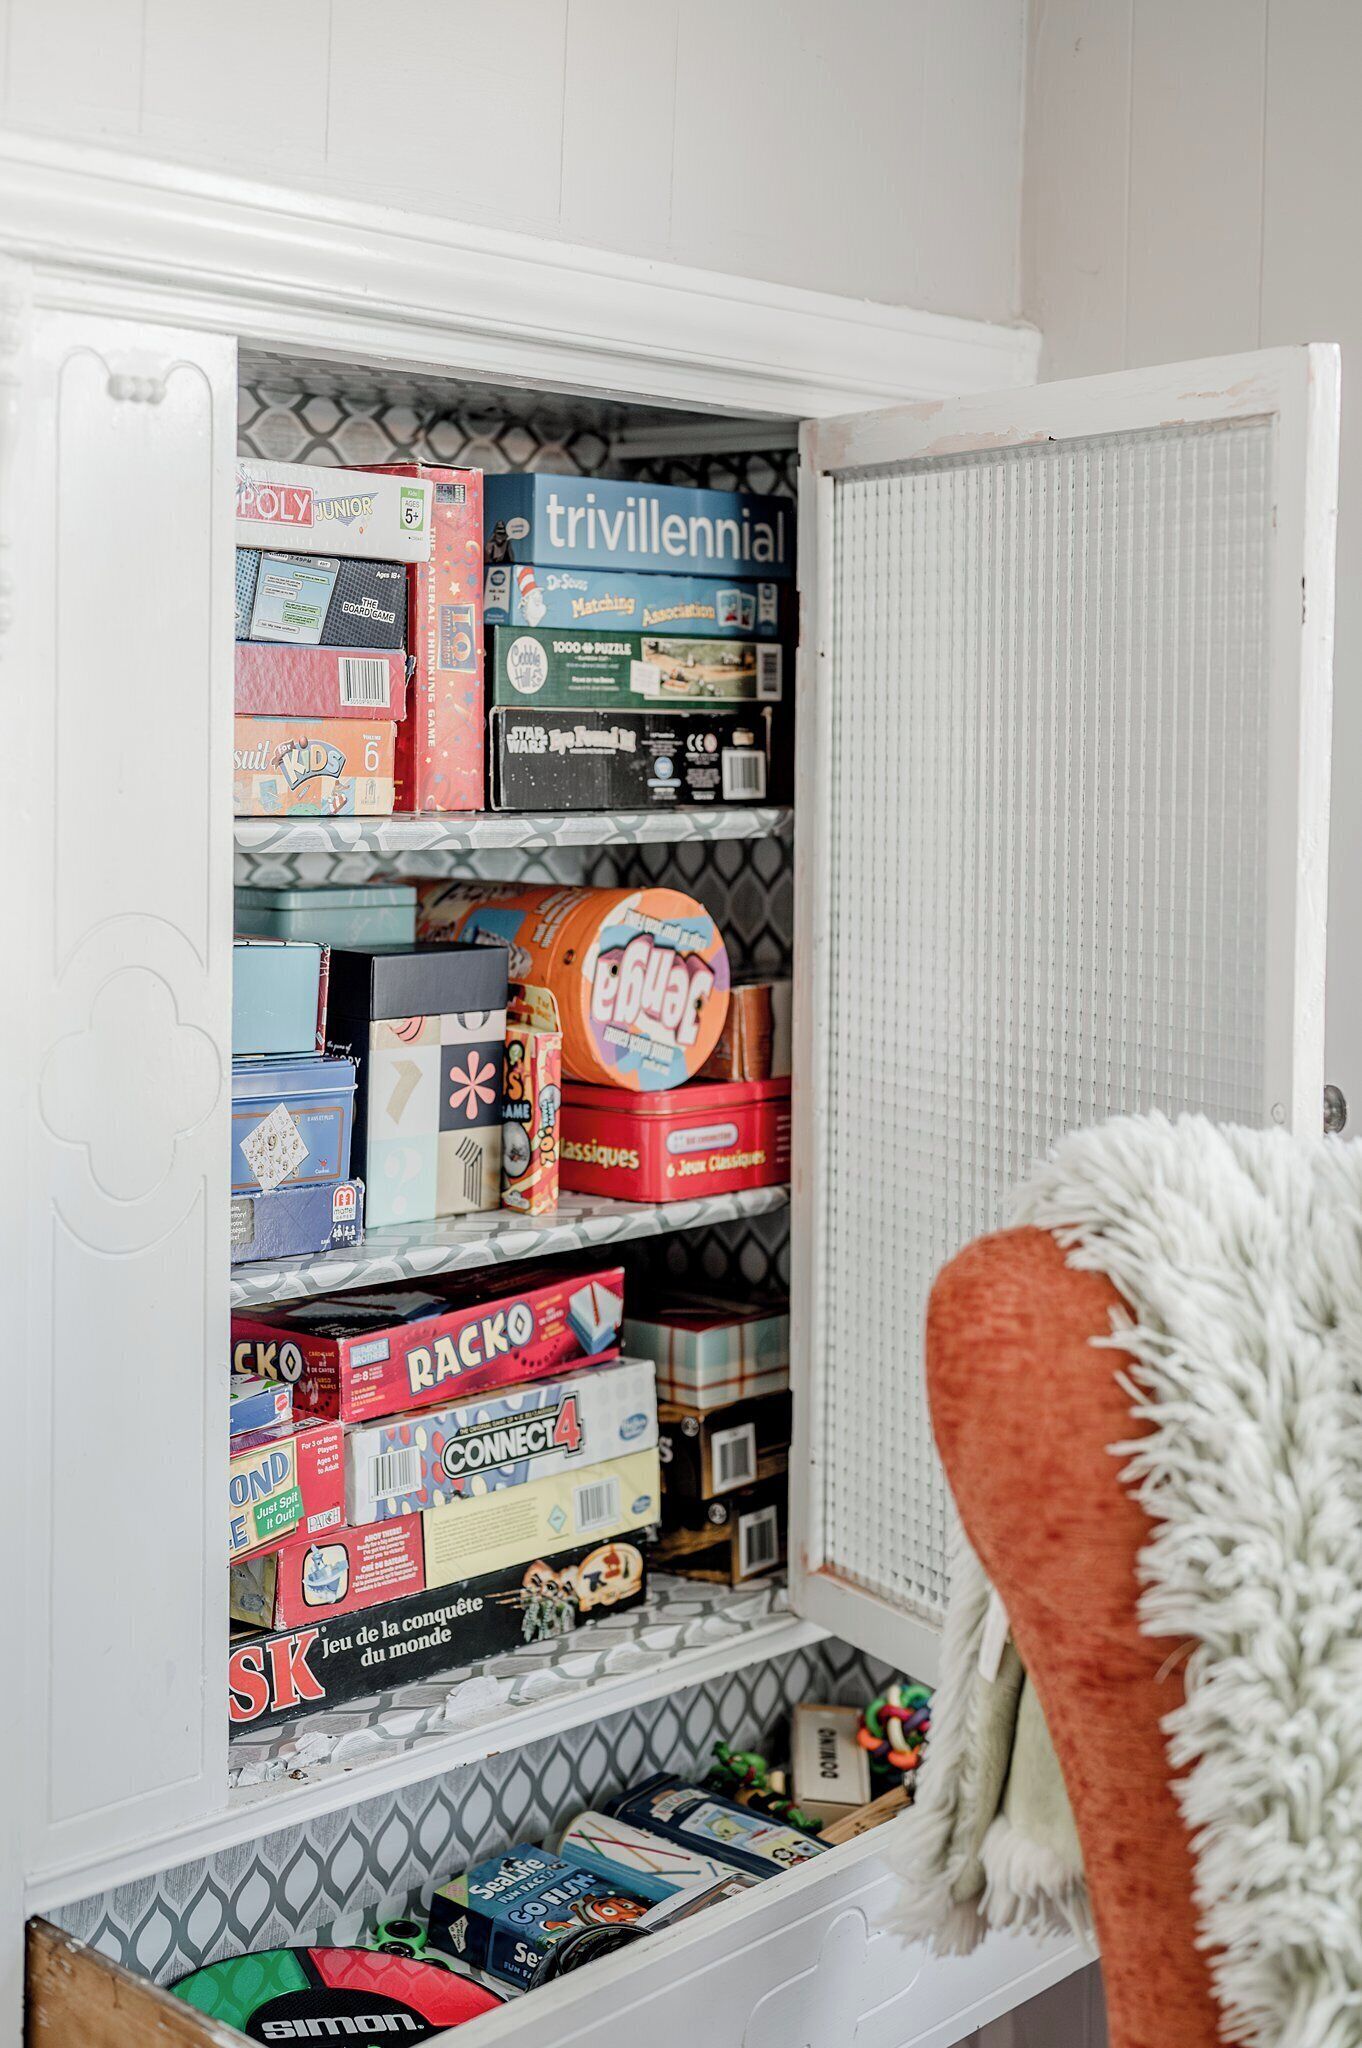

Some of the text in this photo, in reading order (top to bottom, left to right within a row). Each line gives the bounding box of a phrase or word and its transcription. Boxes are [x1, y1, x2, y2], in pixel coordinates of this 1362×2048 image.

[240, 488, 373, 521] POLY JUNIOR
[404, 500, 420, 508] AGES
[405, 508, 419, 524] 5+
[546, 493, 785, 562] trivillennial
[376, 571, 390, 579] Ages
[343, 603, 395, 622] BOARD GAME
[362, 598, 378, 609] THE
[572, 593, 716, 627] Matching Association
[553, 641, 632, 655] 1000 PUZZLE
[427, 629, 436, 703] THINKING
[427, 709, 436, 747] GAME
[506, 726, 547, 740] STAR
[364, 741, 379, 771] 6
[507, 739, 548, 753] WARS
[593, 936, 713, 1045] Jenga
[666, 1150, 766, 1178] 6 Jeux Classiques
[407, 1303, 533, 1393] RACKO
[362, 1371, 369, 1381] 8
[301, 1442, 311, 1450] For
[323, 1435, 338, 1444] More
[317, 1444, 338, 1455] Players
[445, 1419, 556, 1473] CONNECT
[554, 1399, 580, 1450] 4
[317, 1456, 331, 1466] Ages
[324, 1463, 339, 1472] Adult
[257, 1491, 298, 1520] Just Spit
[266, 1518, 273, 1530] it
[322, 1597, 484, 1659] Jeu de la conquête
[360, 1627, 452, 1667] du monde
[229, 1628, 326, 1722] SK
[818, 1727, 839, 1779] DOMINO
[496, 1871, 556, 1905] FUN FACTS
[509, 1901, 548, 1924] GO
[503, 1961, 520, 1975] FUN
[261, 2013, 417, 2040] simon
